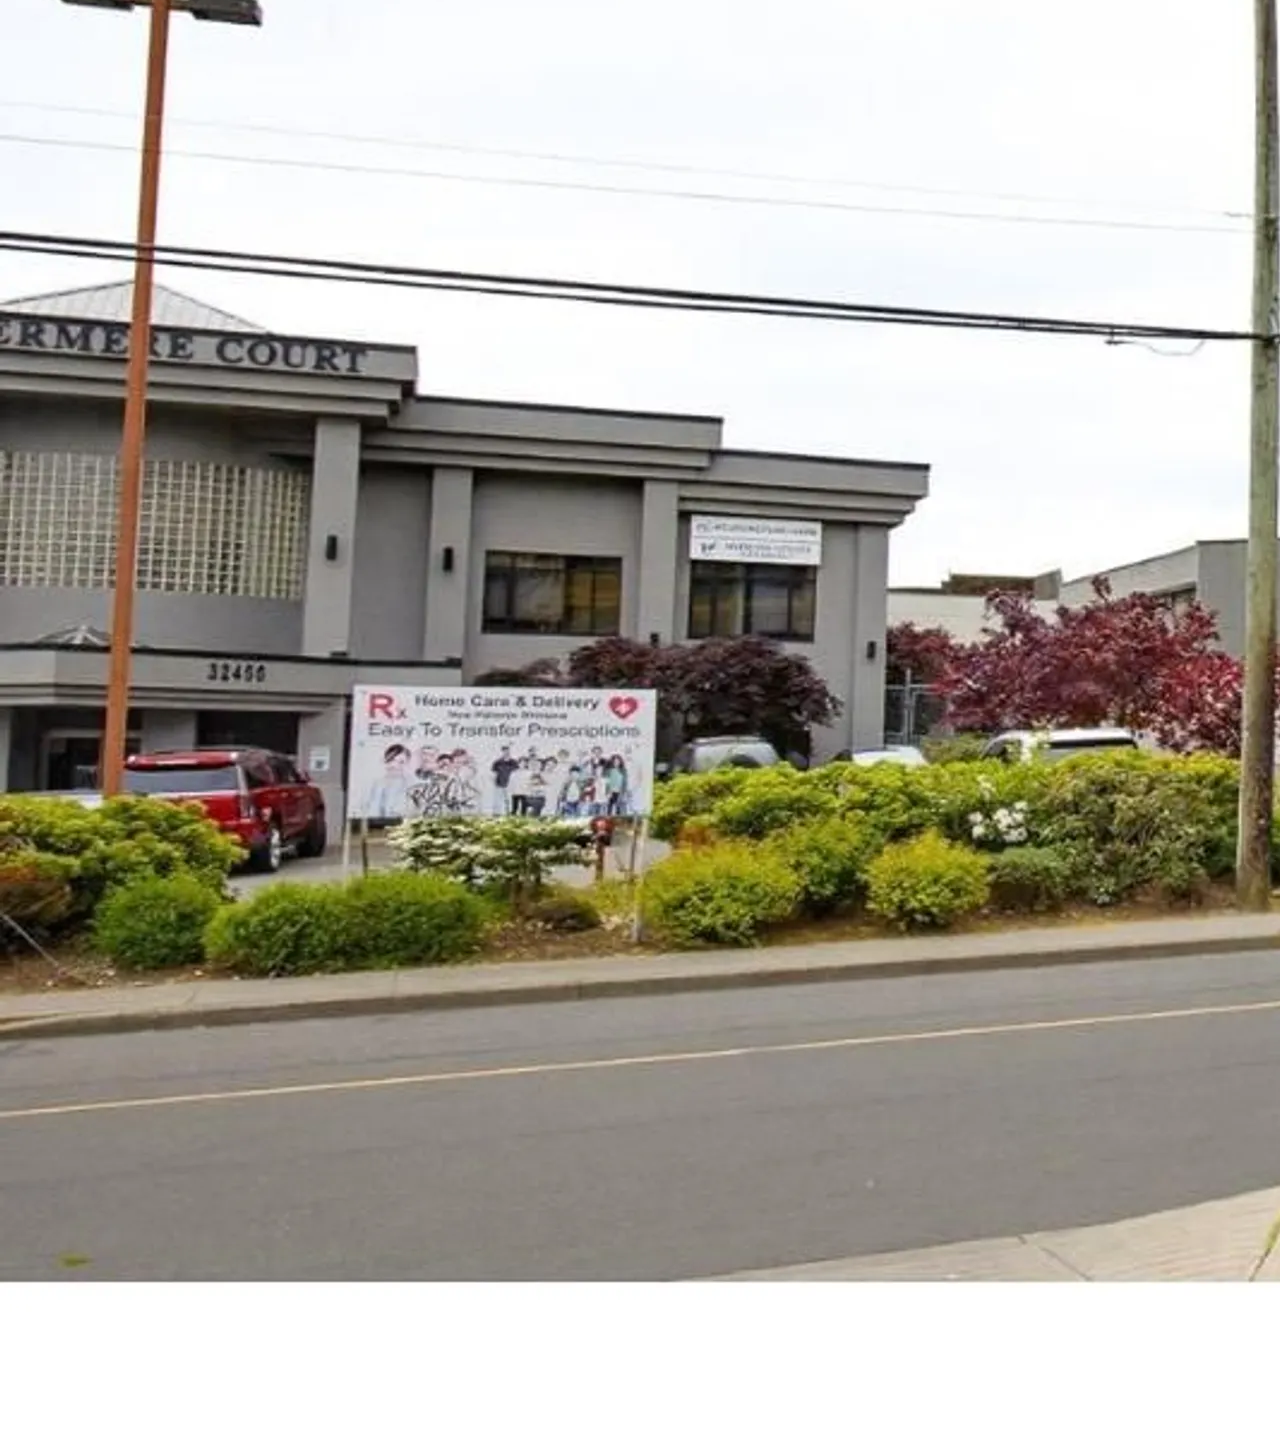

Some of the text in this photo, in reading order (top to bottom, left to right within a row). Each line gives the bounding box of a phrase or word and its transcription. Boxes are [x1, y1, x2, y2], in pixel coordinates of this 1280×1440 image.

[216, 337, 368, 374] COURT
[471, 695, 510, 707] Care
[516, 696, 526, 707] &
[532, 696, 600, 711] Delivery
[368, 722, 414, 738] Easy
[419, 722, 442, 737] To
[528, 722, 641, 739] Prescriptions
